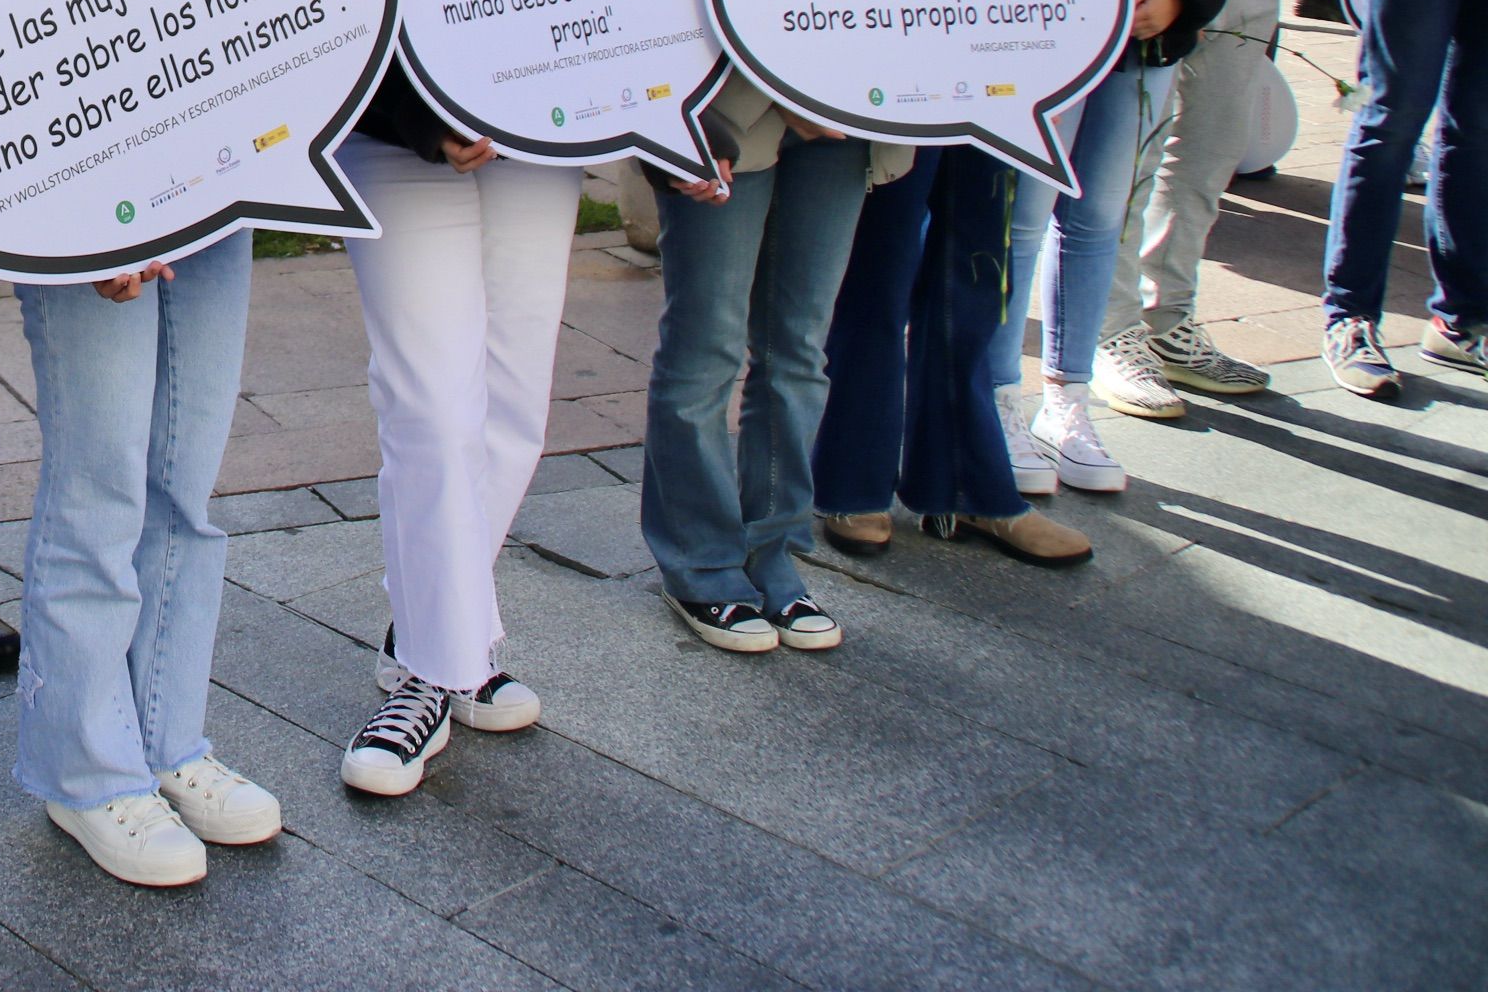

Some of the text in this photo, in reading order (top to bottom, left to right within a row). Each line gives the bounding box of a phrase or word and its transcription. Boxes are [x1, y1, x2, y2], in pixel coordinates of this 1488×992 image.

[9, 8, 57, 49] las
[56, 28, 146, 86] sobre
[150, 1, 196, 42] los
[784, 2, 856, 31] sobre
[865, 8, 892, 29] su
[901, 0, 977, 36] propio
[971, 40, 1056, 52] MARGARET SANGER
[492, 27, 705, 84] LENA DUNHAM, ACTRIZ Y PRODUCTORA ESTADOUNIDENSE
[14, 143, 126, 203] WOLLSTONECRAFT,
[126, 115, 180, 150] FILÓSOFA
[179, 111, 187, 124] Y
[188, 83, 248, 119] ESCRITORA
[249, 61, 293, 89] INGLESA
[293, 52, 313, 68] DEL
[313, 36, 344, 58] SIGLO
[344, 24, 371, 44] XVIII.
[48, 88, 139, 147] sobre
[147, 48, 214, 99] ellas
